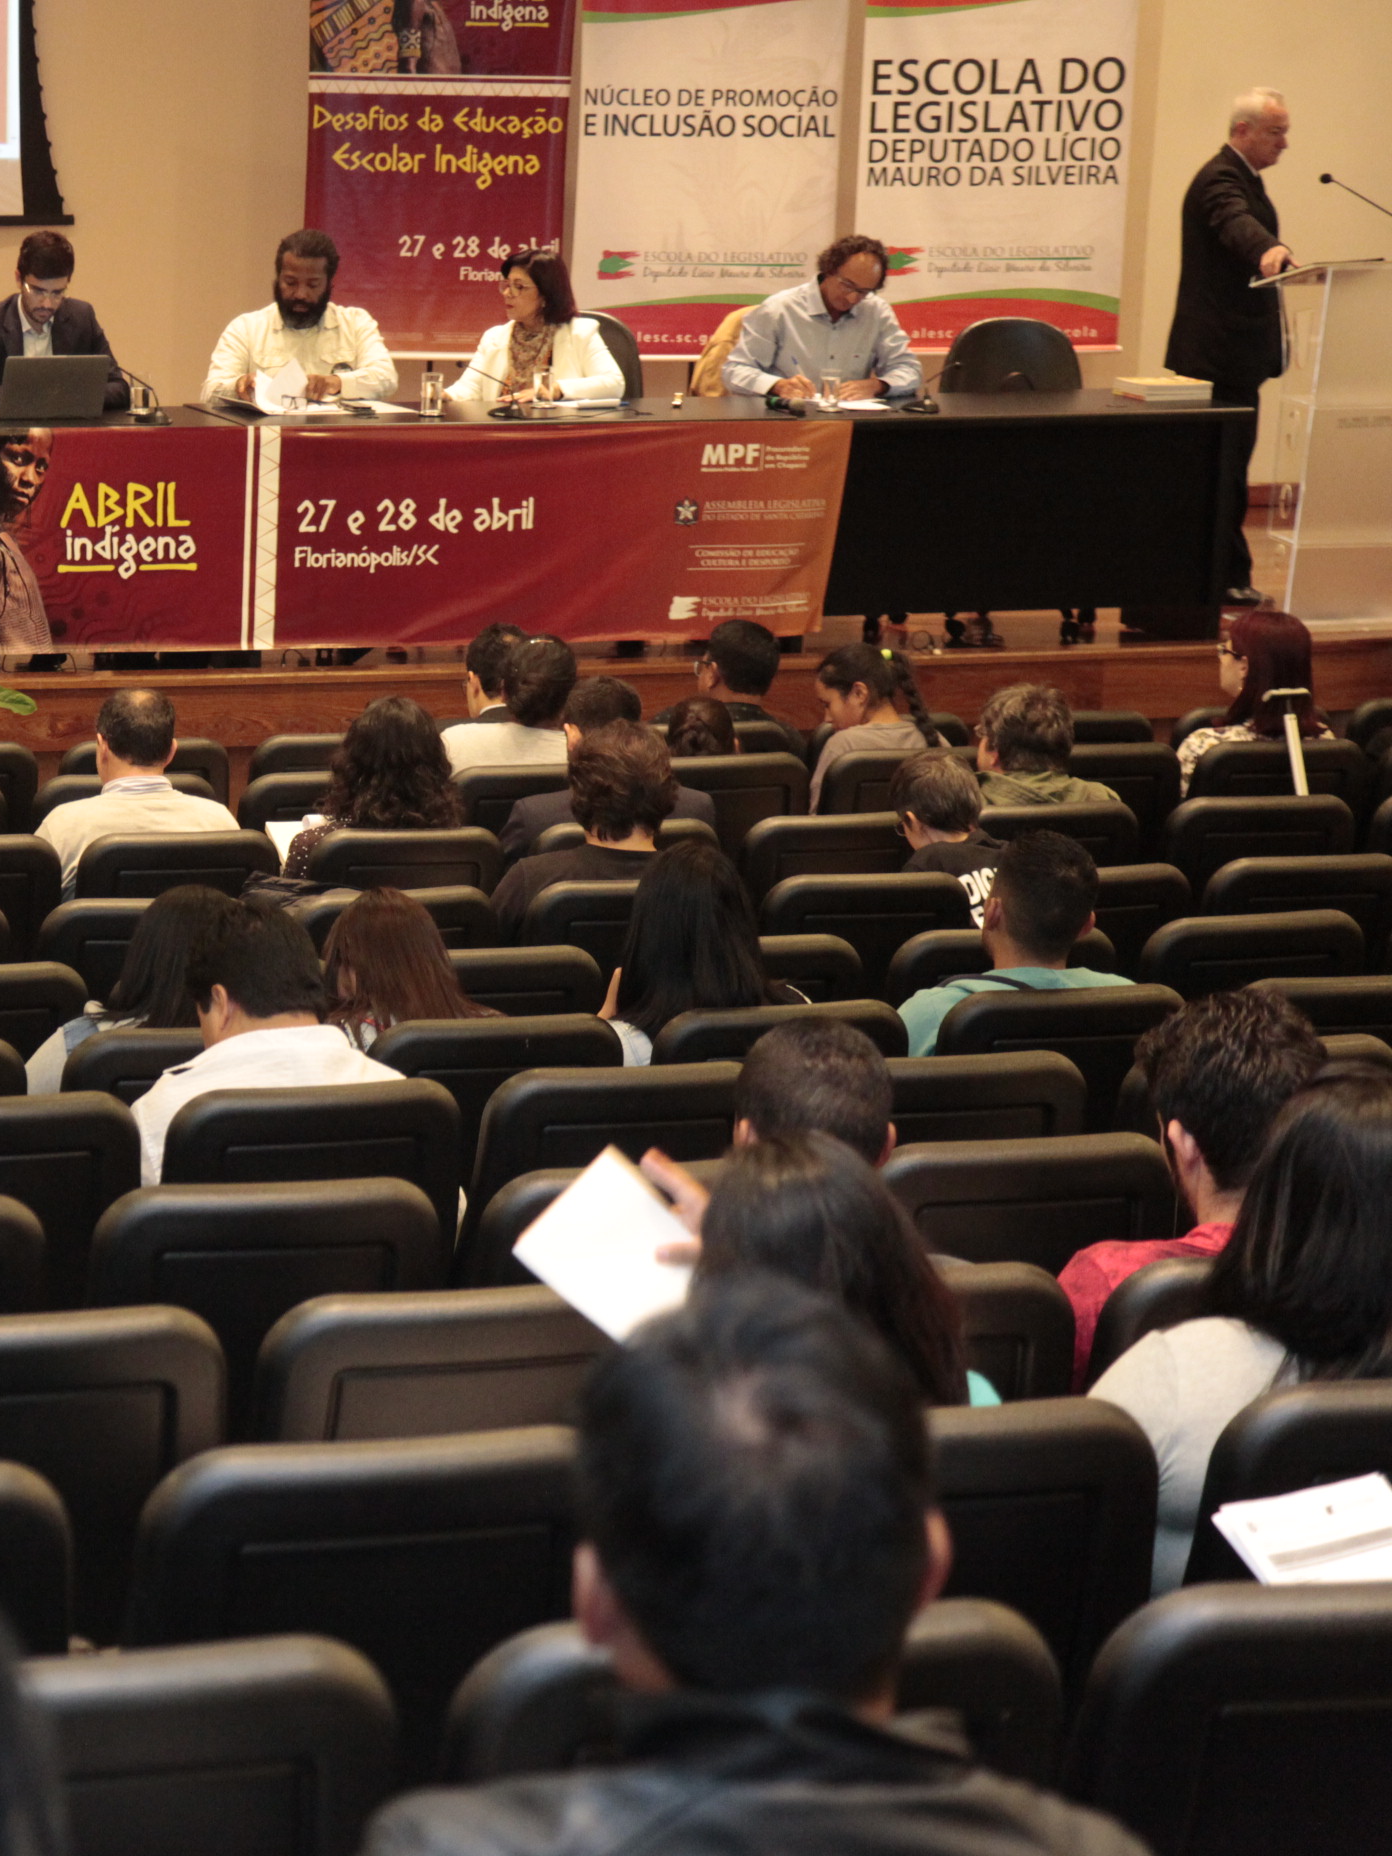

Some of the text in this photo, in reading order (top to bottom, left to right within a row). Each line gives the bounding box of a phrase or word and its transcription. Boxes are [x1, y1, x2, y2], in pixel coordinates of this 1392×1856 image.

[871, 56, 1126, 96] ESCOLA DO
[584, 85, 838, 113] NÚCLEO DE PROMOÇÃO
[312, 104, 564, 139] Desafios da Educação
[584, 111, 836, 138] E INCLUSÃO SOCIAL
[869, 98, 1123, 134] LEGISLATIVO
[331, 142, 426, 173] Escolar
[868, 131, 1122, 163] DEPUTADO LÍCIO
[866, 163, 1120, 187] MAURO DA SILVEIRA
[397, 235, 426, 258] 27
[431, 242, 446, 260] e
[451, 236, 481, 259] 28
[486, 236, 512, 261] de
[643, 251, 808, 264] ESCOLA DO LEGISLATIVO
[928, 246, 979, 259] ESCOLA
[982, 246, 1005, 258] DO
[459, 266, 507, 282] Florian
[636, 331, 710, 346] lesc.sc.g
[910, 325, 1098, 339] alesc cola
[700, 443, 761, 466] MPF
[60, 481, 191, 529] ABRIL
[297, 496, 534, 535] 27 e 28 de abril
[65, 524, 196, 580] indígena
[294, 544, 439, 574] Florianópolis/SC
